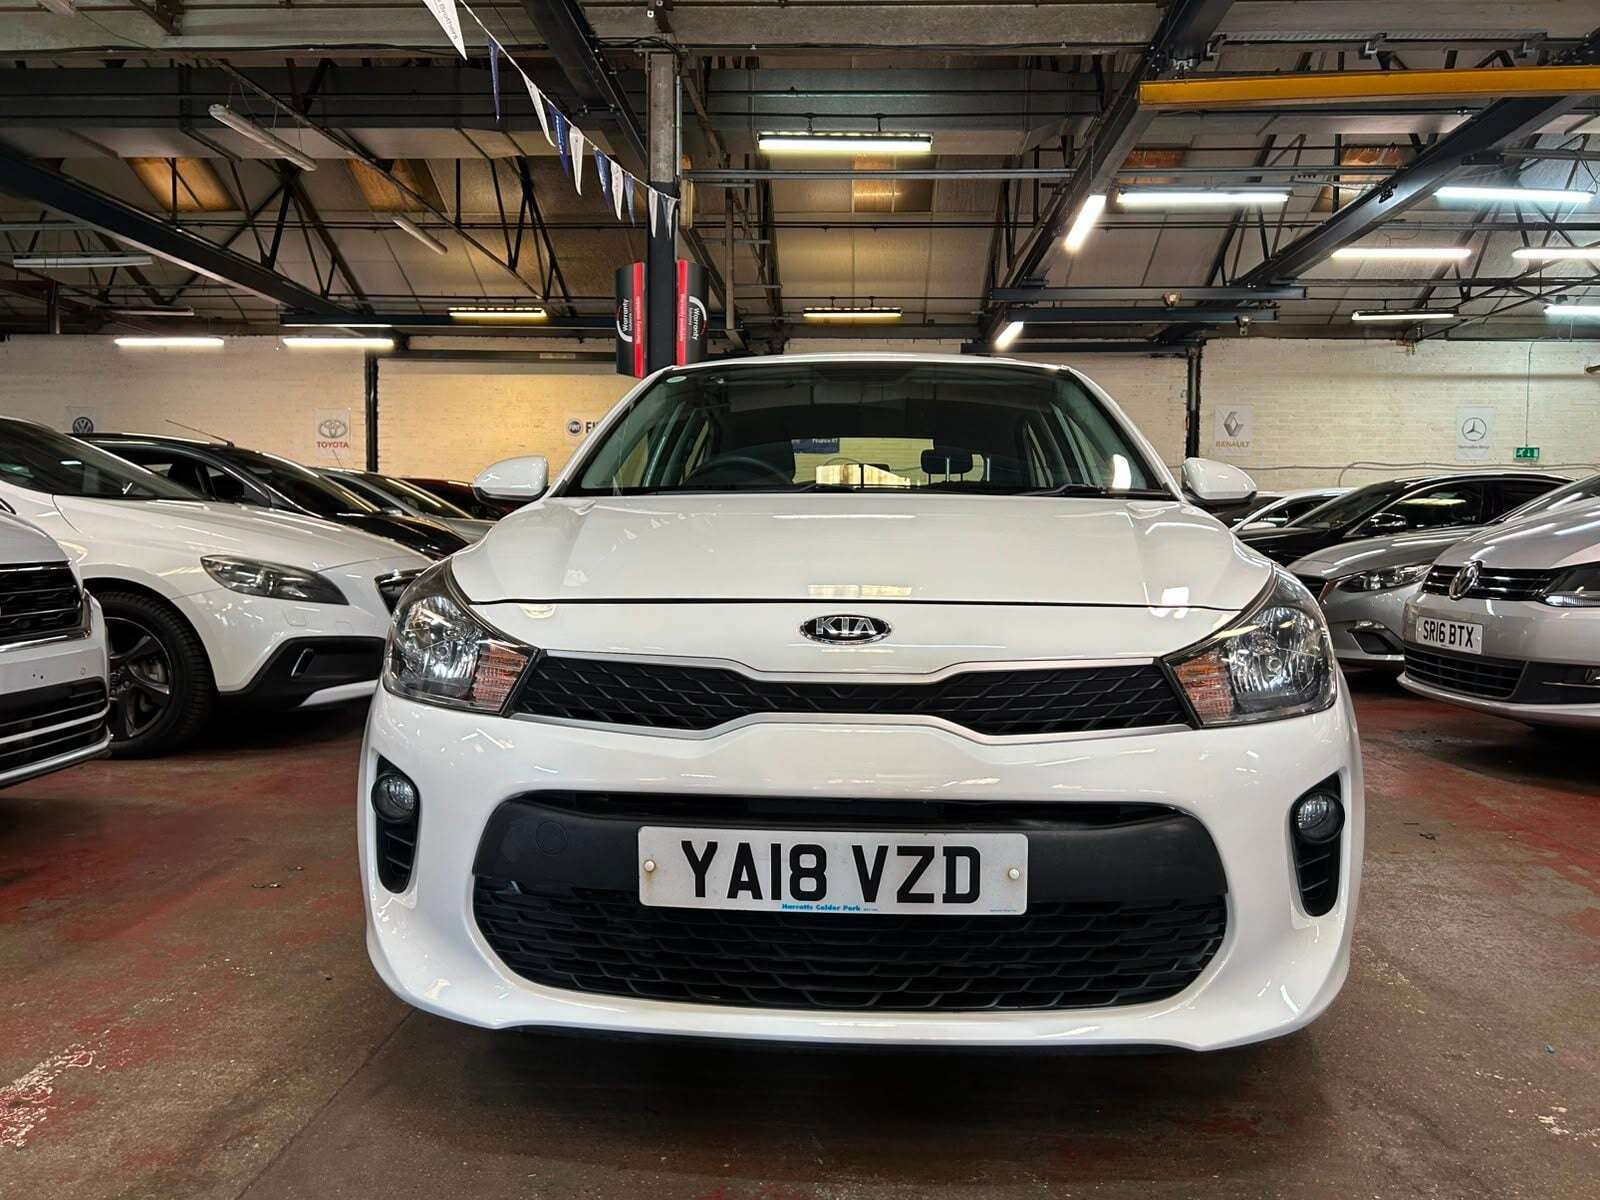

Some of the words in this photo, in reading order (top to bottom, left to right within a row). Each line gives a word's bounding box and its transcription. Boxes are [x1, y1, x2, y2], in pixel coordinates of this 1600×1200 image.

[622, 299, 630, 332] Warranty
[692, 307, 701, 341] Warranty
[1215, 440, 1250, 448] RENAULT
[815, 616, 878, 635] KIA
[1423, 620, 1446, 643] SR16
[1449, 624, 1474, 648] BTX
[681, 840, 828, 901] YA18
[851, 845, 981, 904] VZD
